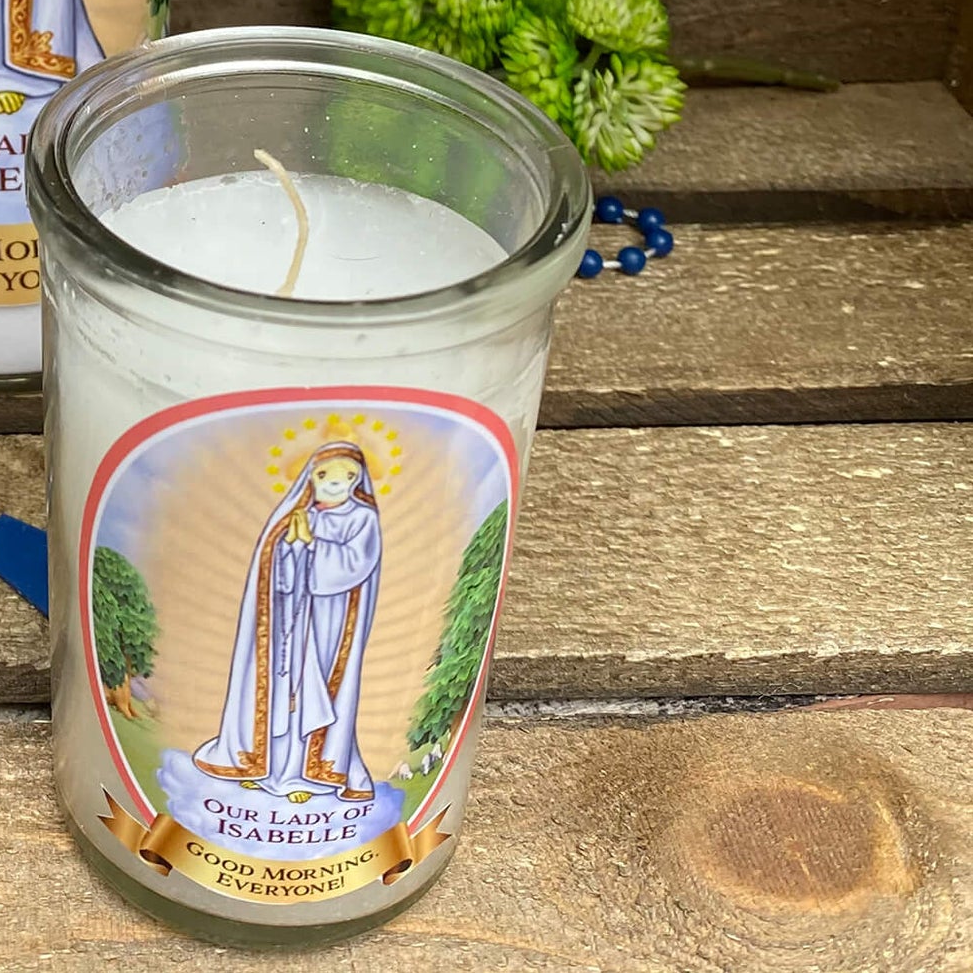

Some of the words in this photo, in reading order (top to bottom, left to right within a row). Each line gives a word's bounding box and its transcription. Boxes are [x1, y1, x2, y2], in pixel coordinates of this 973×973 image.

[203, 798, 260, 823] OUR
[269, 810, 335, 825] LADY
[343, 803, 375, 821] OF
[216, 818, 357, 844] ISABELLE
[186, 841, 255, 877] GOOD
[215, 872, 346, 897] EVERYONE!
